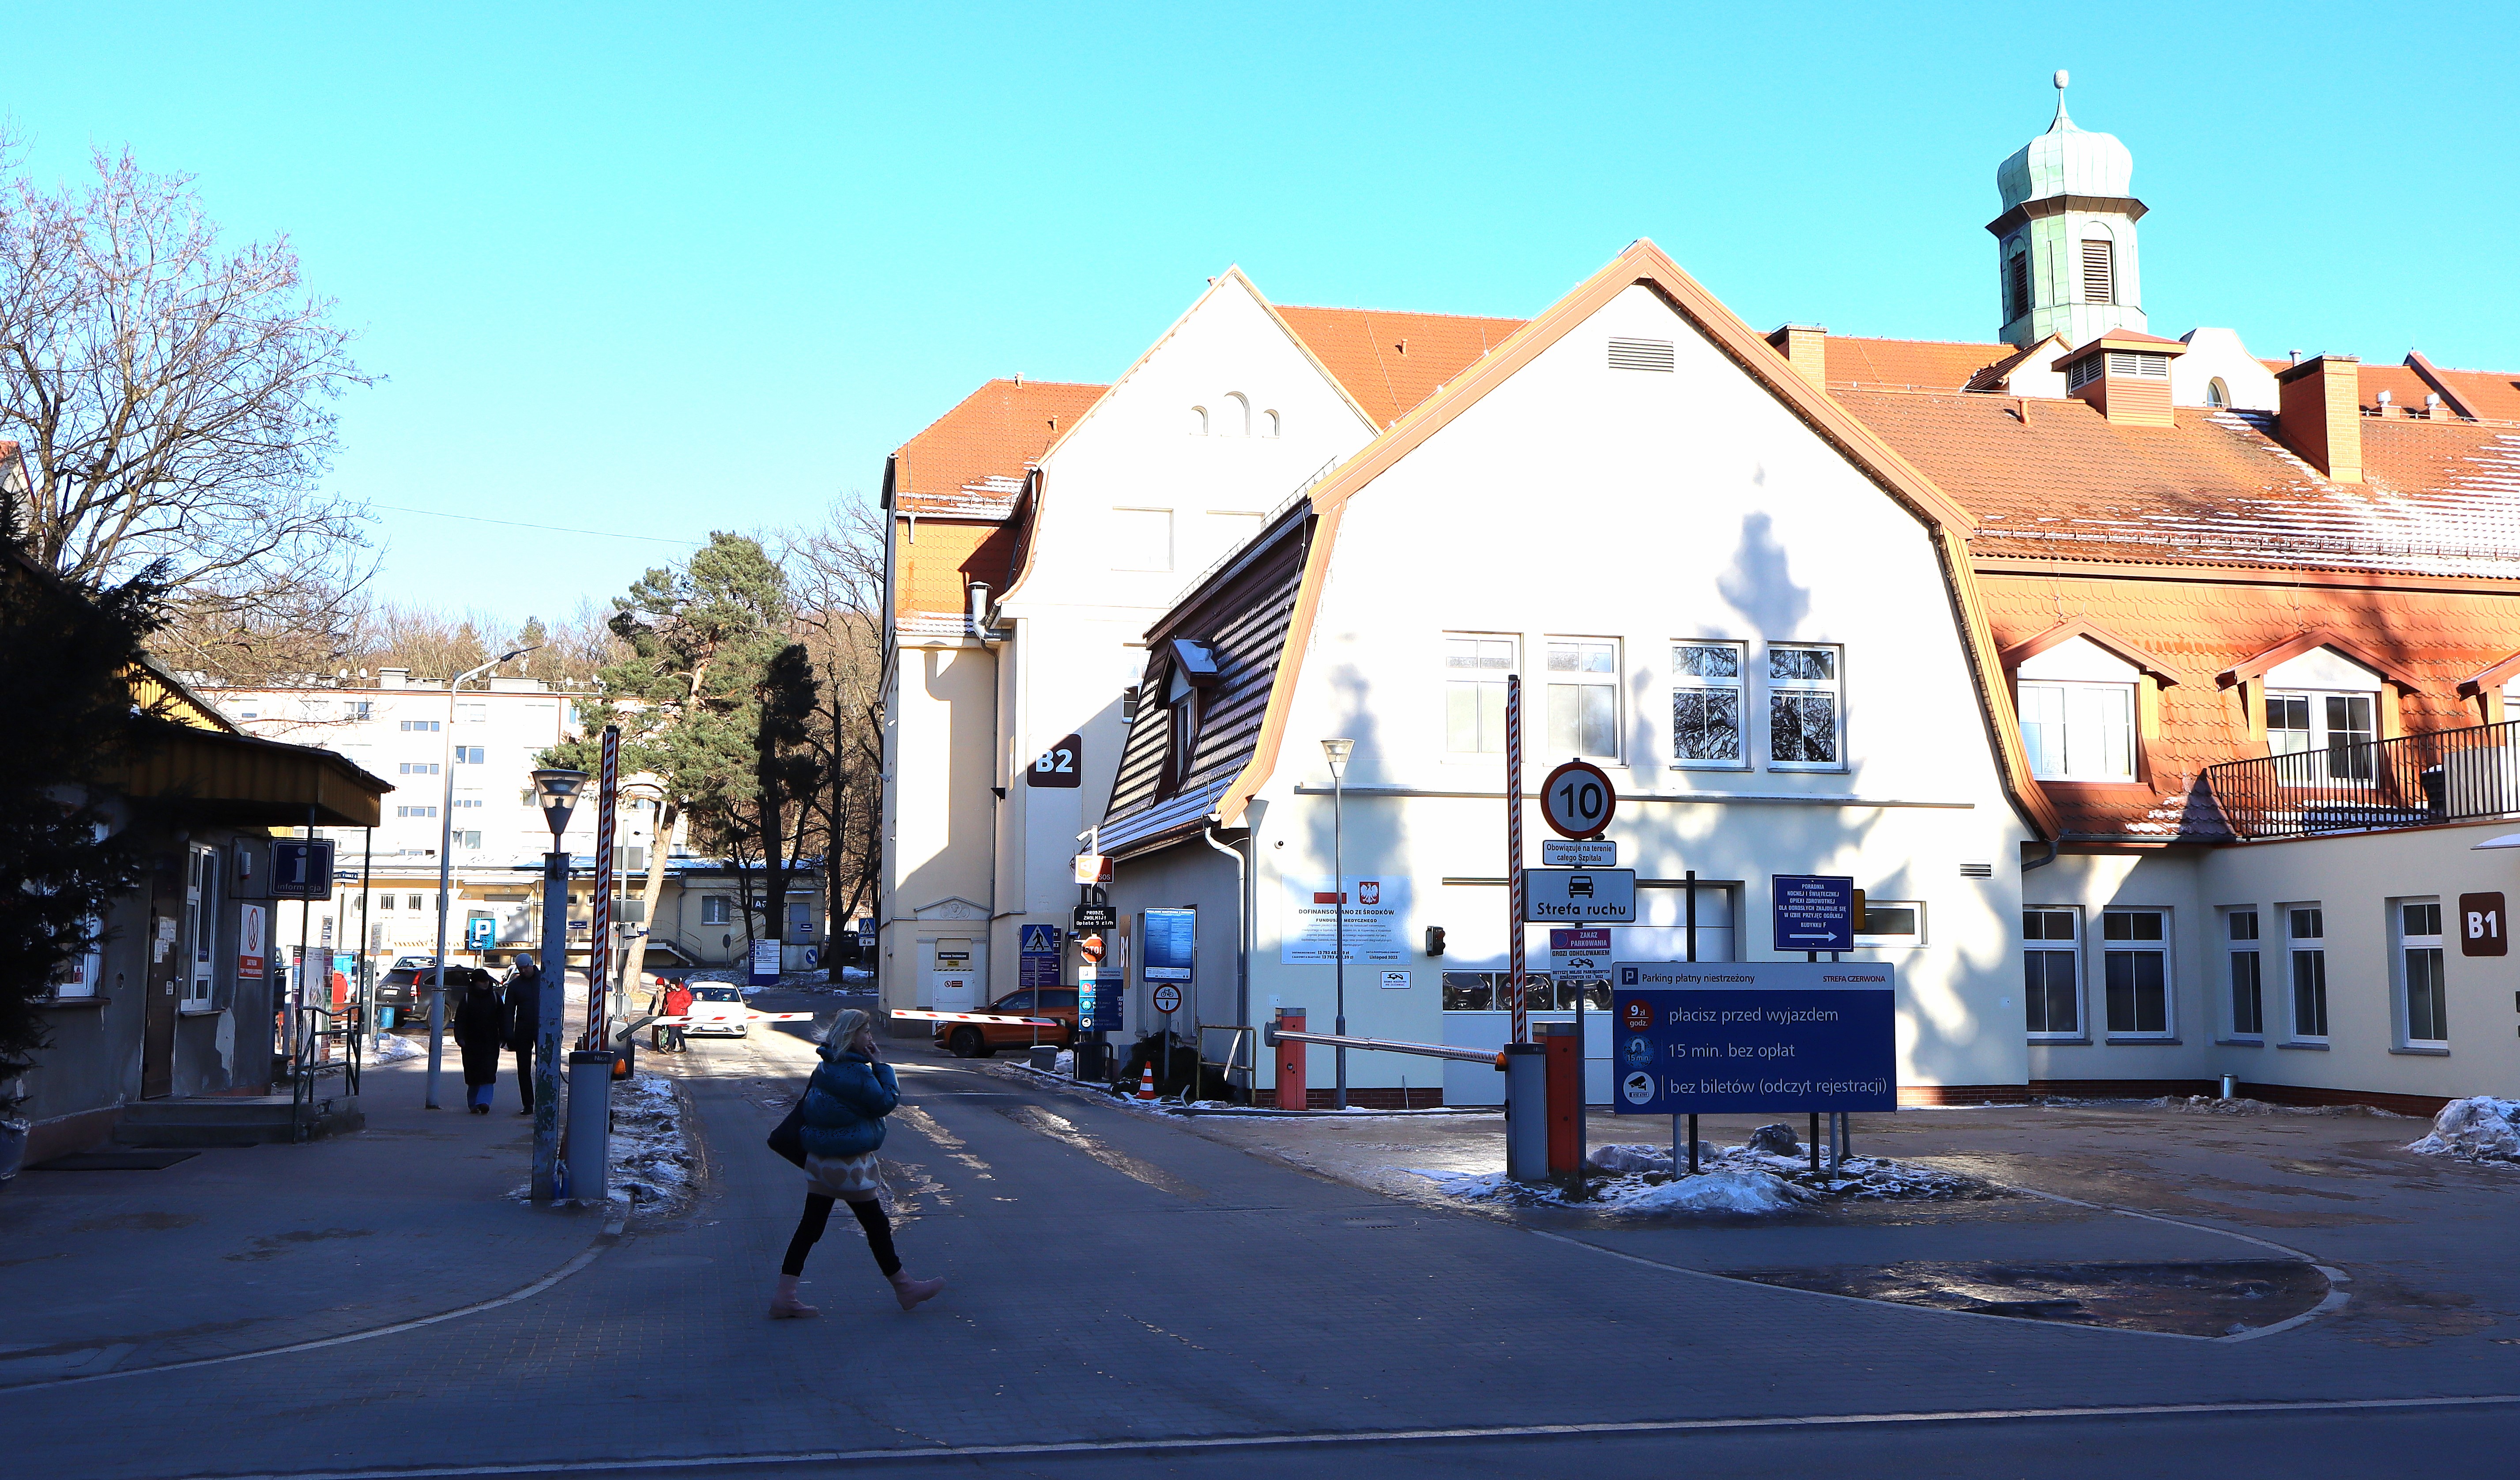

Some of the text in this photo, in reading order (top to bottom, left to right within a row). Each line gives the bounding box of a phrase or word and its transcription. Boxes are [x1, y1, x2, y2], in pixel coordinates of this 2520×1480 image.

[1036, 748, 1073, 773] B2
[1559, 783, 1602, 819] 10
[1547, 844, 1581, 853] Obowiązuje
[1578, 854, 1602, 863] Szpitala
[278, 883, 321, 892] informcja
[1537, 902, 1626, 915] Strefa ruchu
[475, 920, 491, 940] P
[2467, 910, 2497, 939] B1
[1085, 946, 1104, 954] STOP
[1120, 936, 1129, 968] B1
[1625, 970, 1634, 982] P
[1642, 973, 1755, 984] Parking płatny niestrzeżony
[1631, 1005, 1639, 1016] 9
[1669, 1007, 1838, 1025] płacisz przed wyjazdem
[1630, 1019, 1648, 1028] godz.
[1668, 1042, 1795, 1061] 15 min. bez opłat
[1671, 1077, 1887, 1096] bez biletów (odczyt rejestracji)
